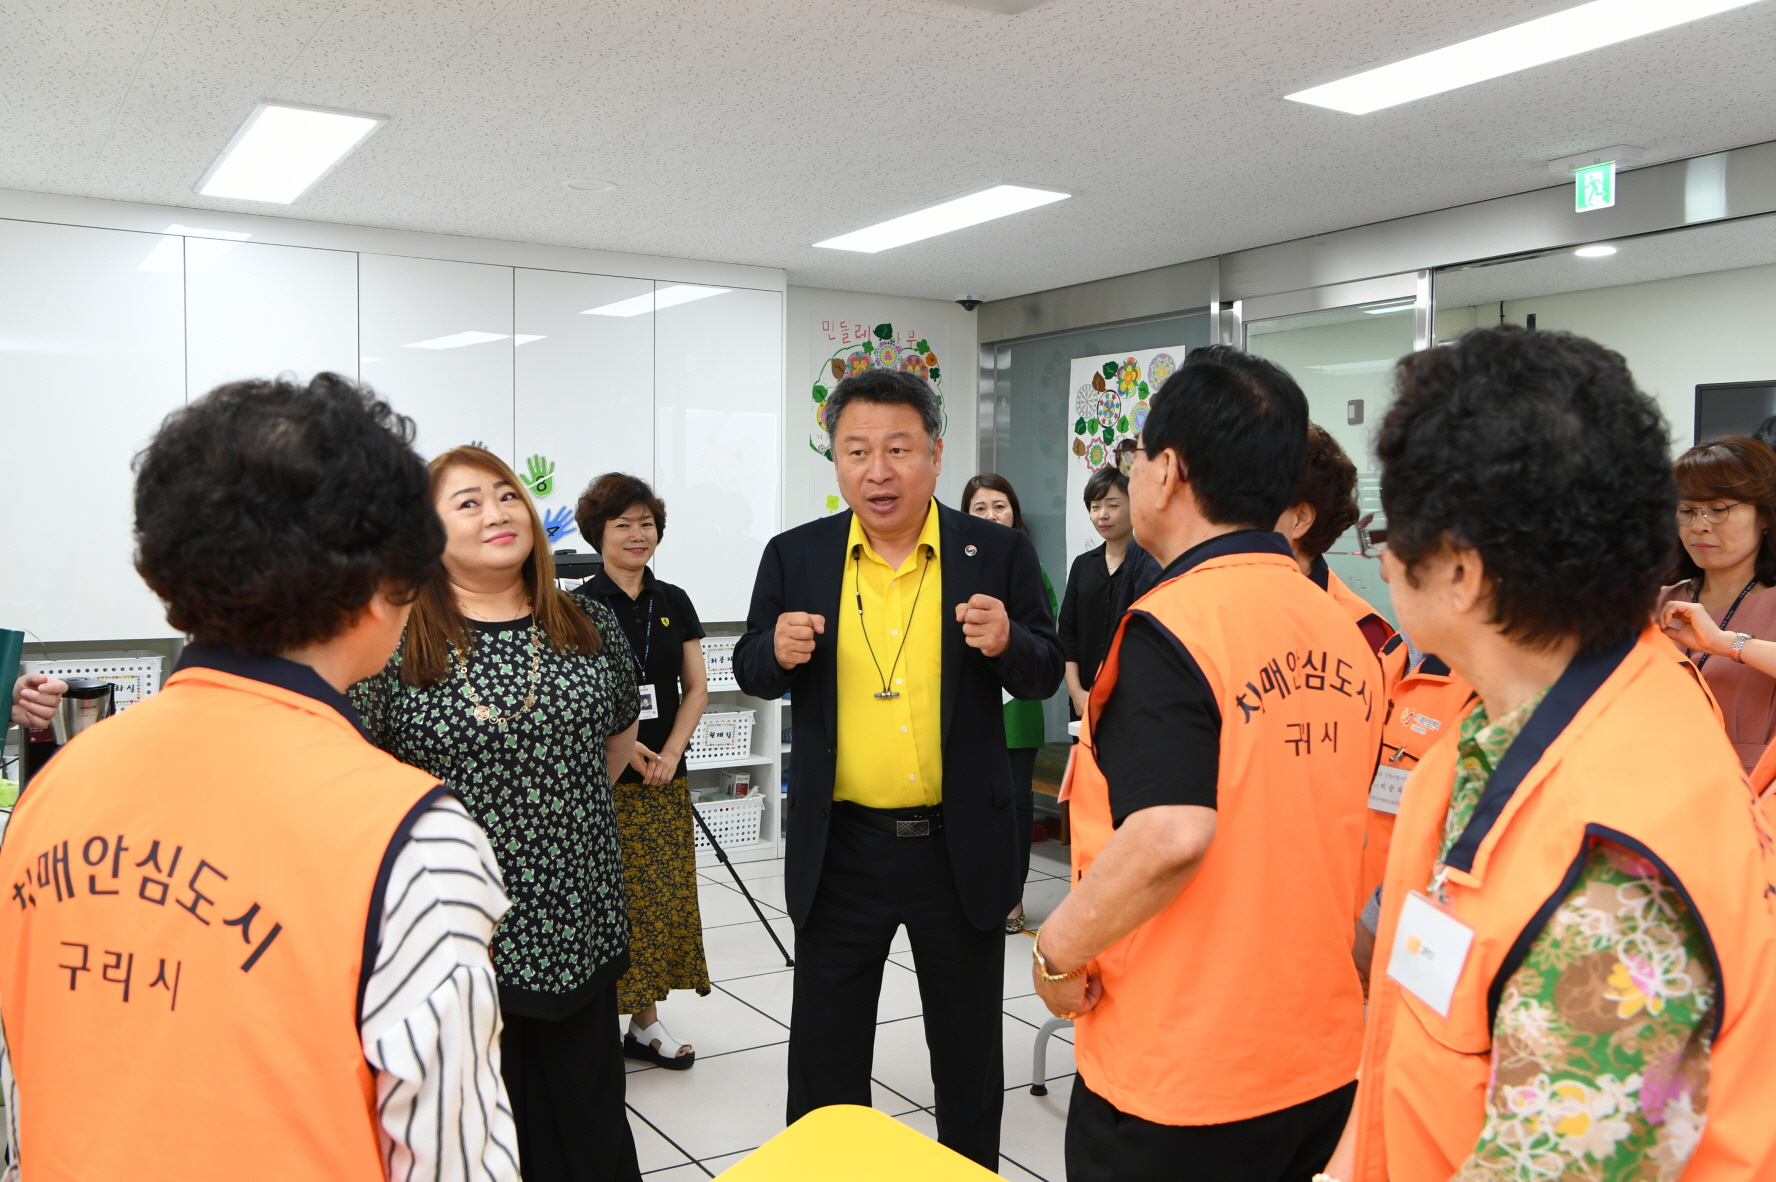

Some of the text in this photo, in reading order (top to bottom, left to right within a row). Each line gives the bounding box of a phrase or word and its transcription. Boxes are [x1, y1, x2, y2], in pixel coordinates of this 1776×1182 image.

[822, 320, 871, 344] 민들레
[545, 525, 560, 537] 4
[12, 834, 283, 973] 치매안심도시
[58, 941, 182, 1012] 구리시
